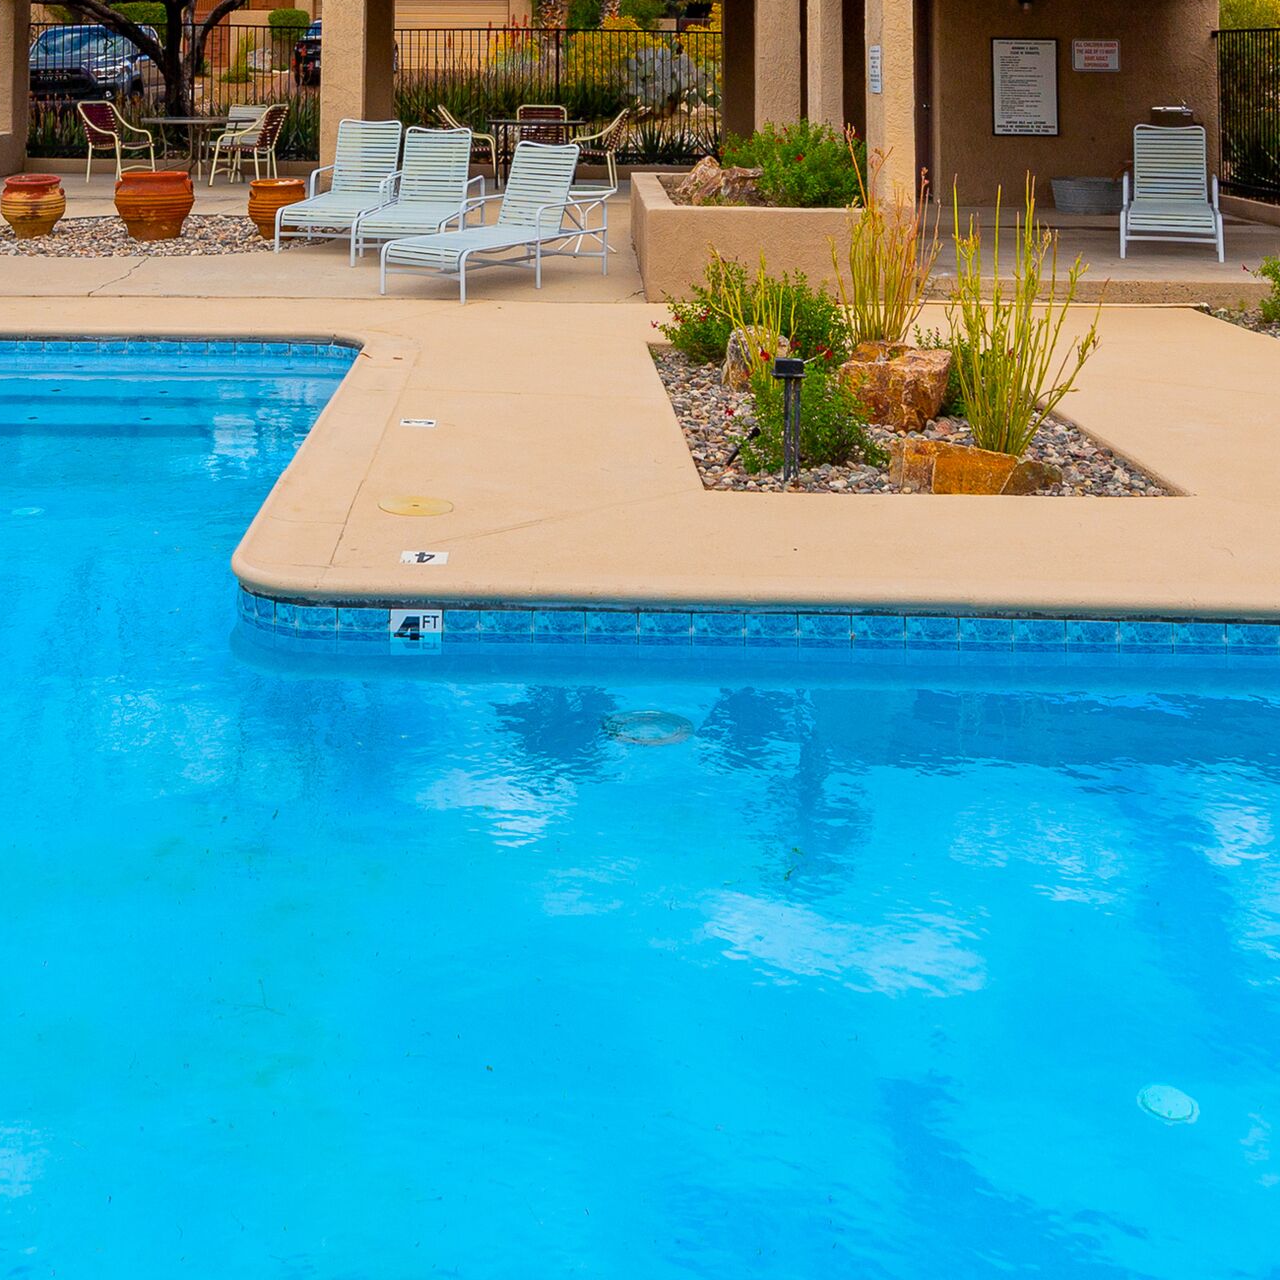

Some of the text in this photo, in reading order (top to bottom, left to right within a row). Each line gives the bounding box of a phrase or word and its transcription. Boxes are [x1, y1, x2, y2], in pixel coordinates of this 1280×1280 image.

[414, 551, 436, 564] 4
[393, 615, 440, 641] 4 FT
